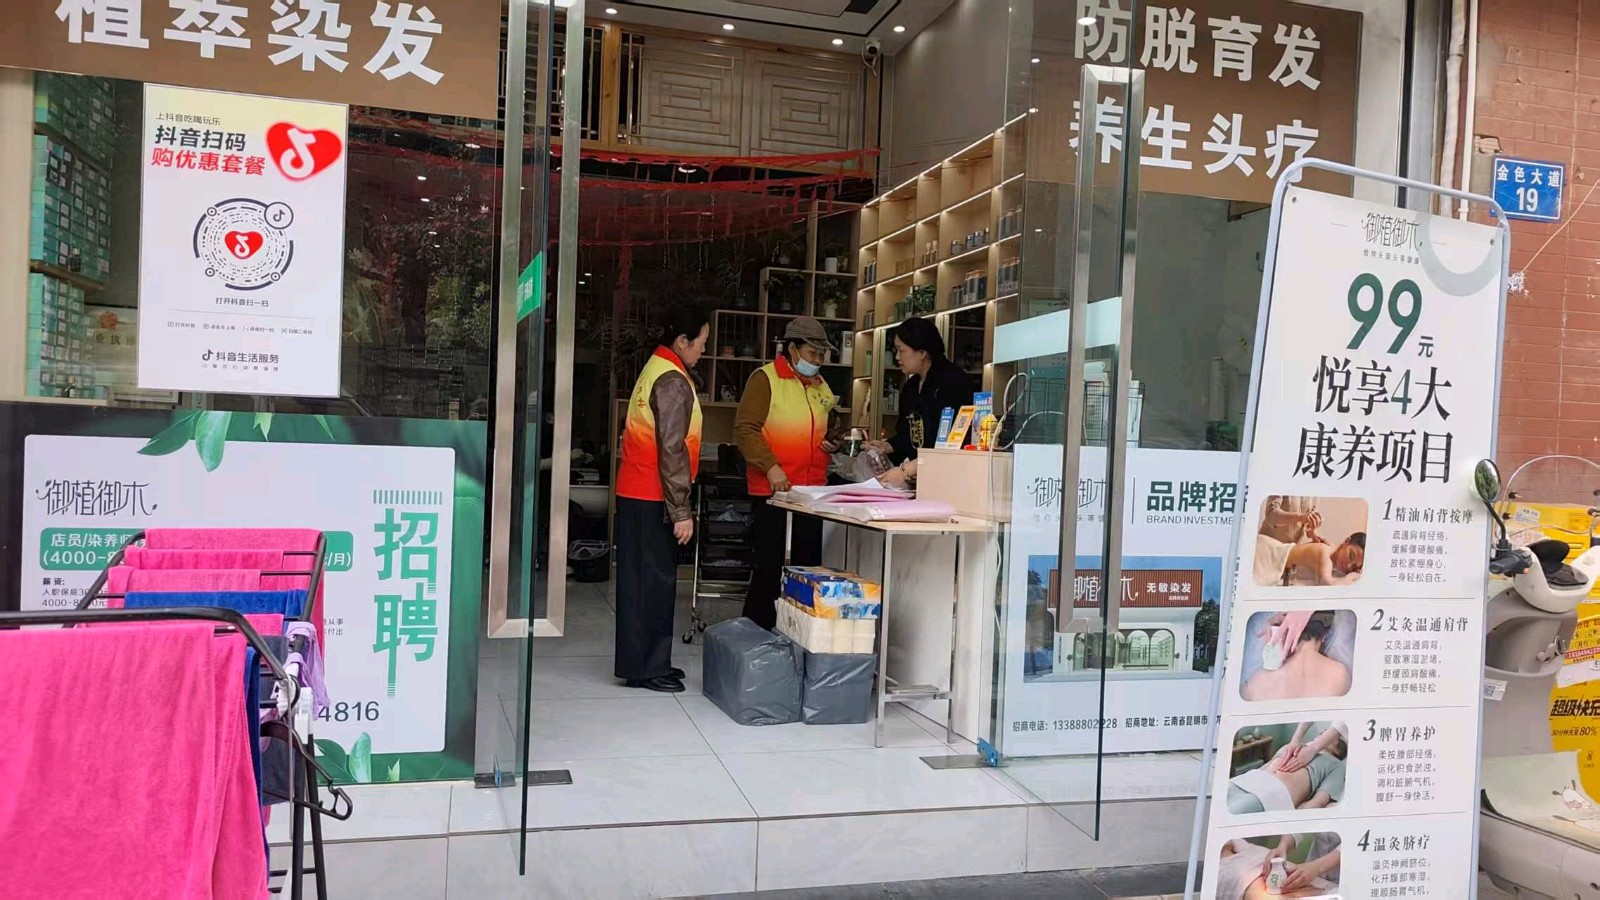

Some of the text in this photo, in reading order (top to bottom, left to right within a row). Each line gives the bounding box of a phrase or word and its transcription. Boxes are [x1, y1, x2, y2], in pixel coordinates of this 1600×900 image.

[55, 0, 444, 85] 植萃染发
[1075, 0, 1321, 90] 防脱育发
[156, 112, 221, 126] 上抖音吃喝玩乐
[155, 125, 246, 151] 抖音扫码
[1069, 96, 1319, 184] 养生头疗
[151, 147, 266, 176] 购优惠套餐
[1496, 163, 1561, 187] 金色大道
[1515, 187, 1539, 212] 19
[1361, 212, 1423, 251] 御植御木
[215, 297, 269, 308] 打开抖音扫一扫
[216, 351, 279, 364] 抖音生活服务
[1312, 354, 1452, 421] 悦享4大
[1292, 421, 1454, 484] 康养项目
[36, 479, 158, 516] 御植御木
[1146, 514, 1182, 524] BRAND
[1146, 582, 1192, 593] 无敏染发
[373, 508, 439, 697] 招聘
[1382, 683, 1436, 693] 一身舒畅轻松
